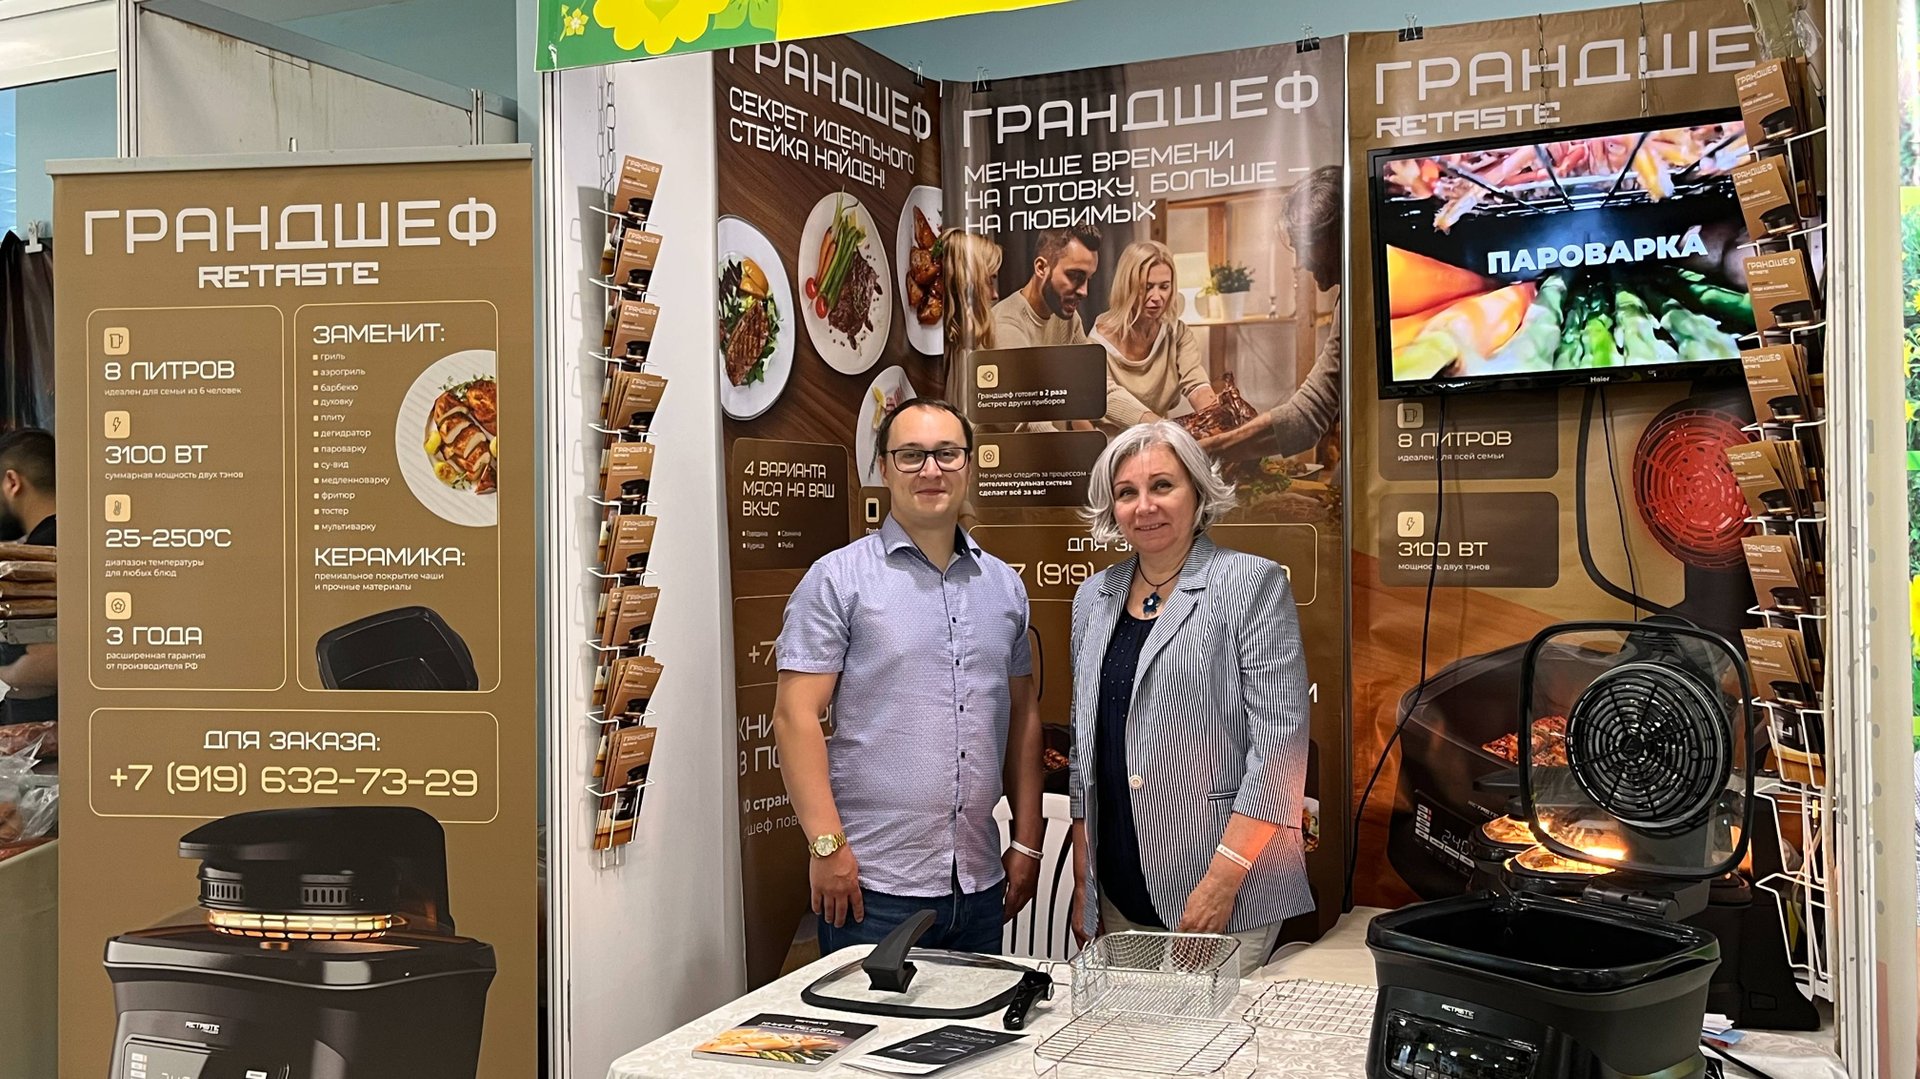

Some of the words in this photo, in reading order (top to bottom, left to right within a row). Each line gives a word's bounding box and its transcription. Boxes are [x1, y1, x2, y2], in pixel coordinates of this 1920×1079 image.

[1375, 24, 1756, 105] ГРАНДШЕ
[962, 70, 1320, 148] ГРАНДШЕФ
[1376, 102, 1560, 138] RETASTE
[729, 87, 808, 132] СЕКРЕТ
[814, 116, 915, 175] ИДЕАЛЬНОГО
[729, 118, 809, 163] СТЕЙКА
[815, 145, 885, 189] НАЙДЕН!
[964, 156, 1085, 185] МЕНЬШЕ
[1093, 139, 1234, 170] ВРЕМЕНИ
[964, 186, 1001, 211] НА
[1008, 177, 1139, 207] ГОТОВКУ,
[1150, 163, 1277, 193] БОЛЬШЕ
[964, 213, 1001, 235] НА
[1008, 201, 1158, 232] ЛЮБИМЫХ
[85, 198, 496, 255] ГРАНДШЕФ
[1487, 226, 1709, 275] ПАРОВАРКА
[199, 262, 378, 288] RETASTE
[313, 323, 444, 343] ЗАМЕНИТ:
[320, 353, 346, 362] гриль
[105, 363, 121, 380] 8
[131, 361, 234, 380] ЛИТРОВ
[320, 368, 366, 377] аэрогриль
[104, 389, 141, 397] идеален
[142, 388, 159, 396] для
[160, 388, 186, 396] семьи
[199, 386, 206, 395] 6
[206, 387, 242, 395] человек
[320, 383, 359, 393] барбекю
[977, 391, 1014, 400] Грандшеф
[1015, 390, 1038, 398] готовит
[320, 398, 354, 407] духовку
[977, 400, 1007, 408] быстрее
[1032, 398, 1065, 406] приборов
[320, 414, 346, 423] плиту
[320, 430, 372, 438] дегидратор
[1398, 434, 1413, 448] 8
[1421, 430, 1513, 447] ЛИТРОВ
[106, 446, 165, 463] 3100
[175, 445, 208, 463] ВТ
[321, 445, 367, 454] пароварку
[1398, 454, 1434, 462] идеален
[1454, 453, 1474, 461] всей
[1476, 452, 1504, 461] семьи
[320, 461, 350, 470] су-вид
[744, 461, 754, 476] 4
[759, 462, 826, 479] ВАРИАНТА
[104, 472, 153, 481] суммарная
[154, 472, 198, 480] мощность
[197, 471, 218, 481] двух
[219, 471, 244, 479] тэнов
[321, 477, 391, 486] медленноварку
[1013, 471, 1040, 479] следить
[1049, 470, 1086, 478] процессом
[321, 491, 356, 501] фритюр
[743, 481, 782, 496] МЯСА
[787, 482, 805, 497] НА
[809, 483, 834, 498] ВАШ
[979, 489, 1008, 497] сделает
[321, 508, 350, 516] тостер
[742, 501, 780, 516] ВКУС
[321, 523, 377, 532] мультиварку
[1067, 538, 1107, 551] ДЛЯ
[1398, 541, 1451, 557] 3100
[1458, 541, 1488, 557] ВТ
[104, 559, 147, 567] диапазон
[148, 559, 205, 568] температуры
[315, 548, 465, 566] КЕРАМИКА:
[104, 570, 121, 578] для
[122, 568, 152, 577] любых
[153, 568, 177, 578] блюд
[1037, 561, 1094, 587] (919)
[1398, 563, 1442, 571] мощнось
[1443, 563, 1463, 571] двух
[1465, 563, 1490, 571] тэнов
[314, 573, 374, 581] премиальное
[375, 573, 419, 582] покрытие
[322, 583, 361, 592] прочные
[362, 583, 412, 592] материалы
[107, 627, 123, 644] 3
[133, 627, 202, 645] ГОДА
[106, 652, 166, 661] расширенная
[167, 652, 206, 661] гарантия
[748, 641, 776, 665] +7
[116, 663, 184, 671] производителя
[184, 662, 198, 670] РФ
[739, 714, 774, 741] КНИ
[204, 731, 259, 749] ДЛЯ
[270, 732, 380, 750] ЗАКАЗА:
[755, 746, 780, 772] ПО
[110, 765, 152, 790] +7
[168, 762, 246, 795] (919)
[262, 767, 477, 796] 632-73-29
[753, 793, 790, 811] стран
[744, 817, 772, 838] шеф
[776, 814, 800, 828] пов
